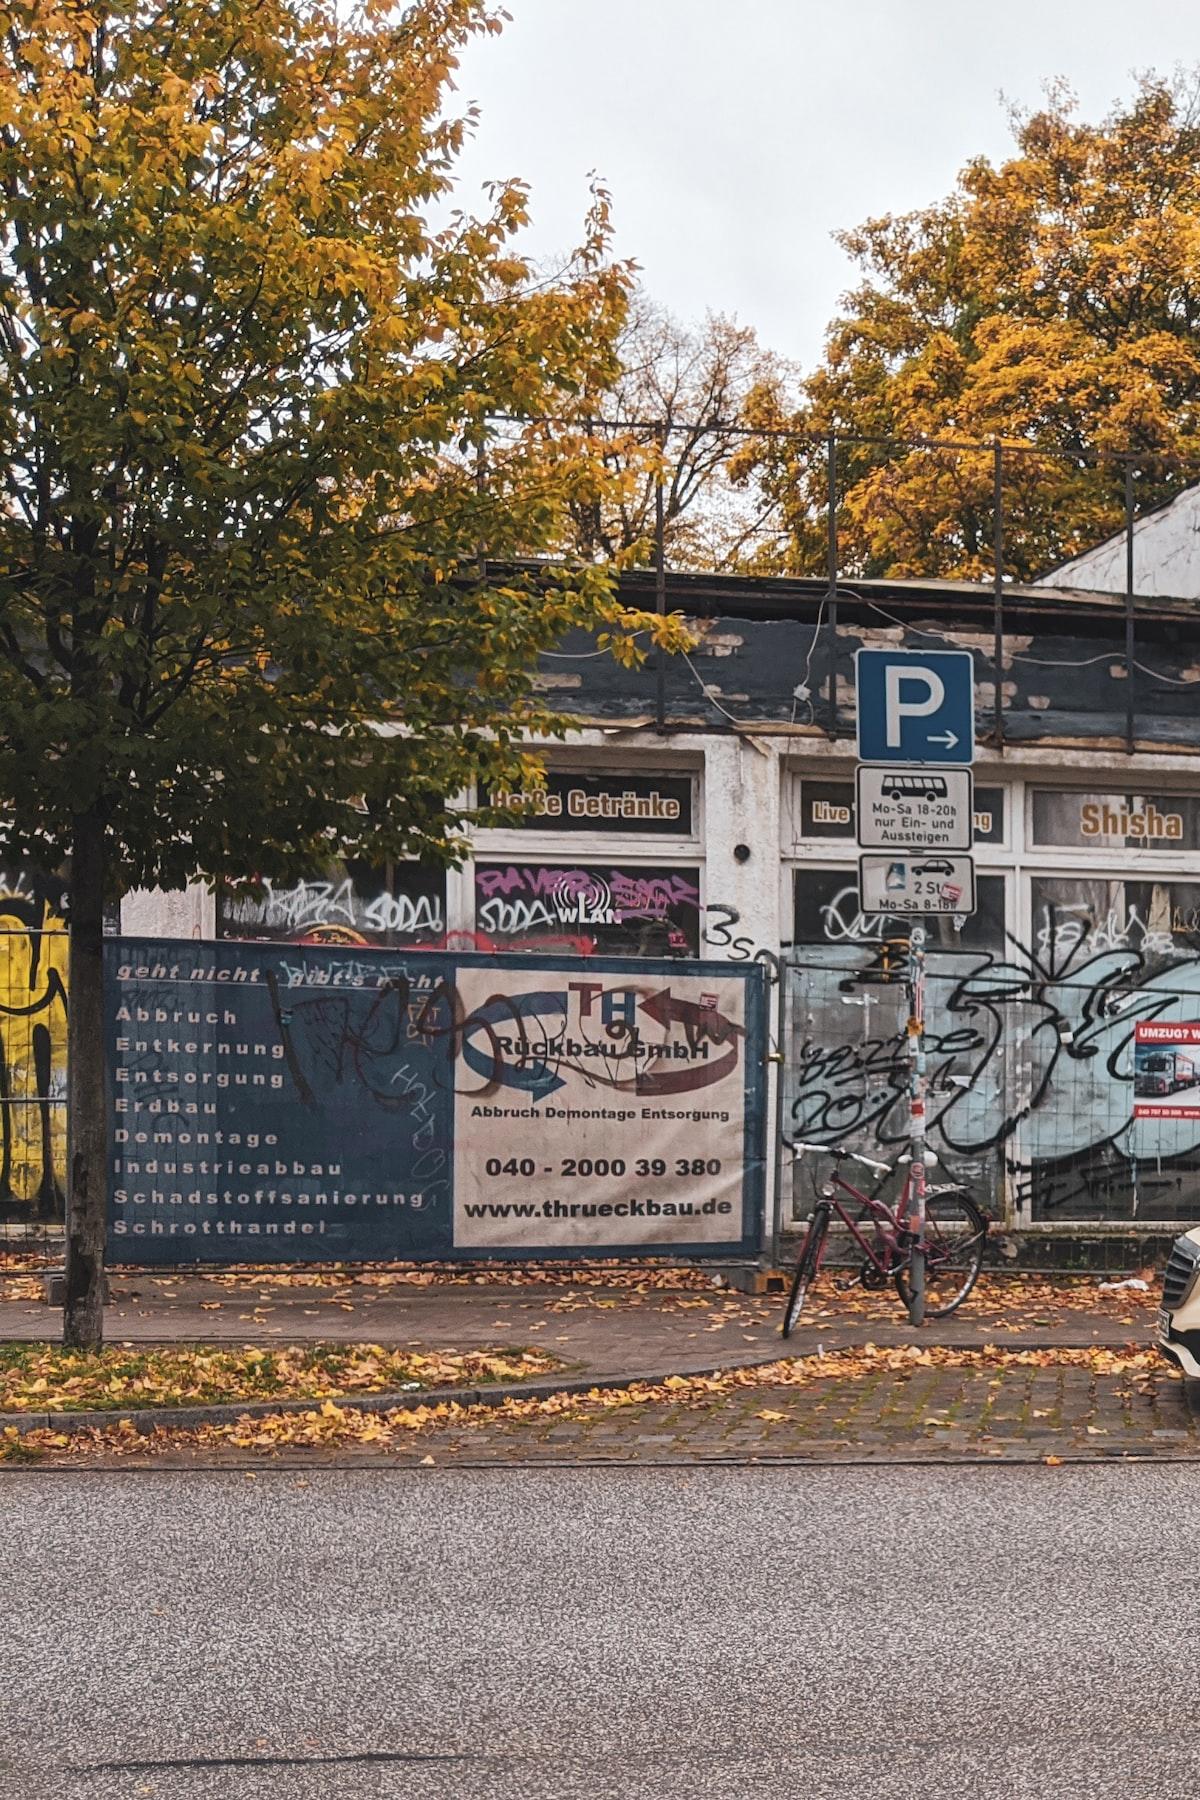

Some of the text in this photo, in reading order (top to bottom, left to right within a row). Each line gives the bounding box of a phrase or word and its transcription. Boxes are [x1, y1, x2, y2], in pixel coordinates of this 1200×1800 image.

[885, 664, 945, 748] P
[568, 789, 680, 819] Getränke
[813, 801, 851, 824] Live
[872, 802, 957, 816] Mo-Sa 18-20h
[875, 816, 954, 829] nur Ein- und
[1081, 803, 1183, 840] Shisha
[881, 829, 949, 844] Aussteigen
[914, 881, 922, 894] 2
[879, 899, 919, 909] Mo-Sa
[117, 963, 179, 981] geht
[190, 966, 260, 983] nicht
[116, 1006, 237, 1025] Abbruch
[1139, 1027, 1189, 1038] UMZUG?
[116, 1037, 284, 1059] Entkernung
[497, 1035, 709, 1060] Rückbau GmbH
[115, 1067, 284, 1089] Entsorgung
[115, 1099, 217, 1114] Erdbau
[471, 1106, 730, 1122] Abbruch Demontage Entsorgung
[114, 1129, 280, 1148] Demontage
[113, 1159, 342, 1176] Industrieabbau
[486, 1158, 535, 1176] 040
[561, 1159, 626, 1177] 2000
[636, 1159, 666, 1176] 39
[675, 1158, 721, 1176] 380
[113, 1190, 424, 1208] Schadstoffsanierung
[464, 1198, 733, 1217] www.thrueckbau.de
[113, 1221, 327, 1234] Schrotthandel
